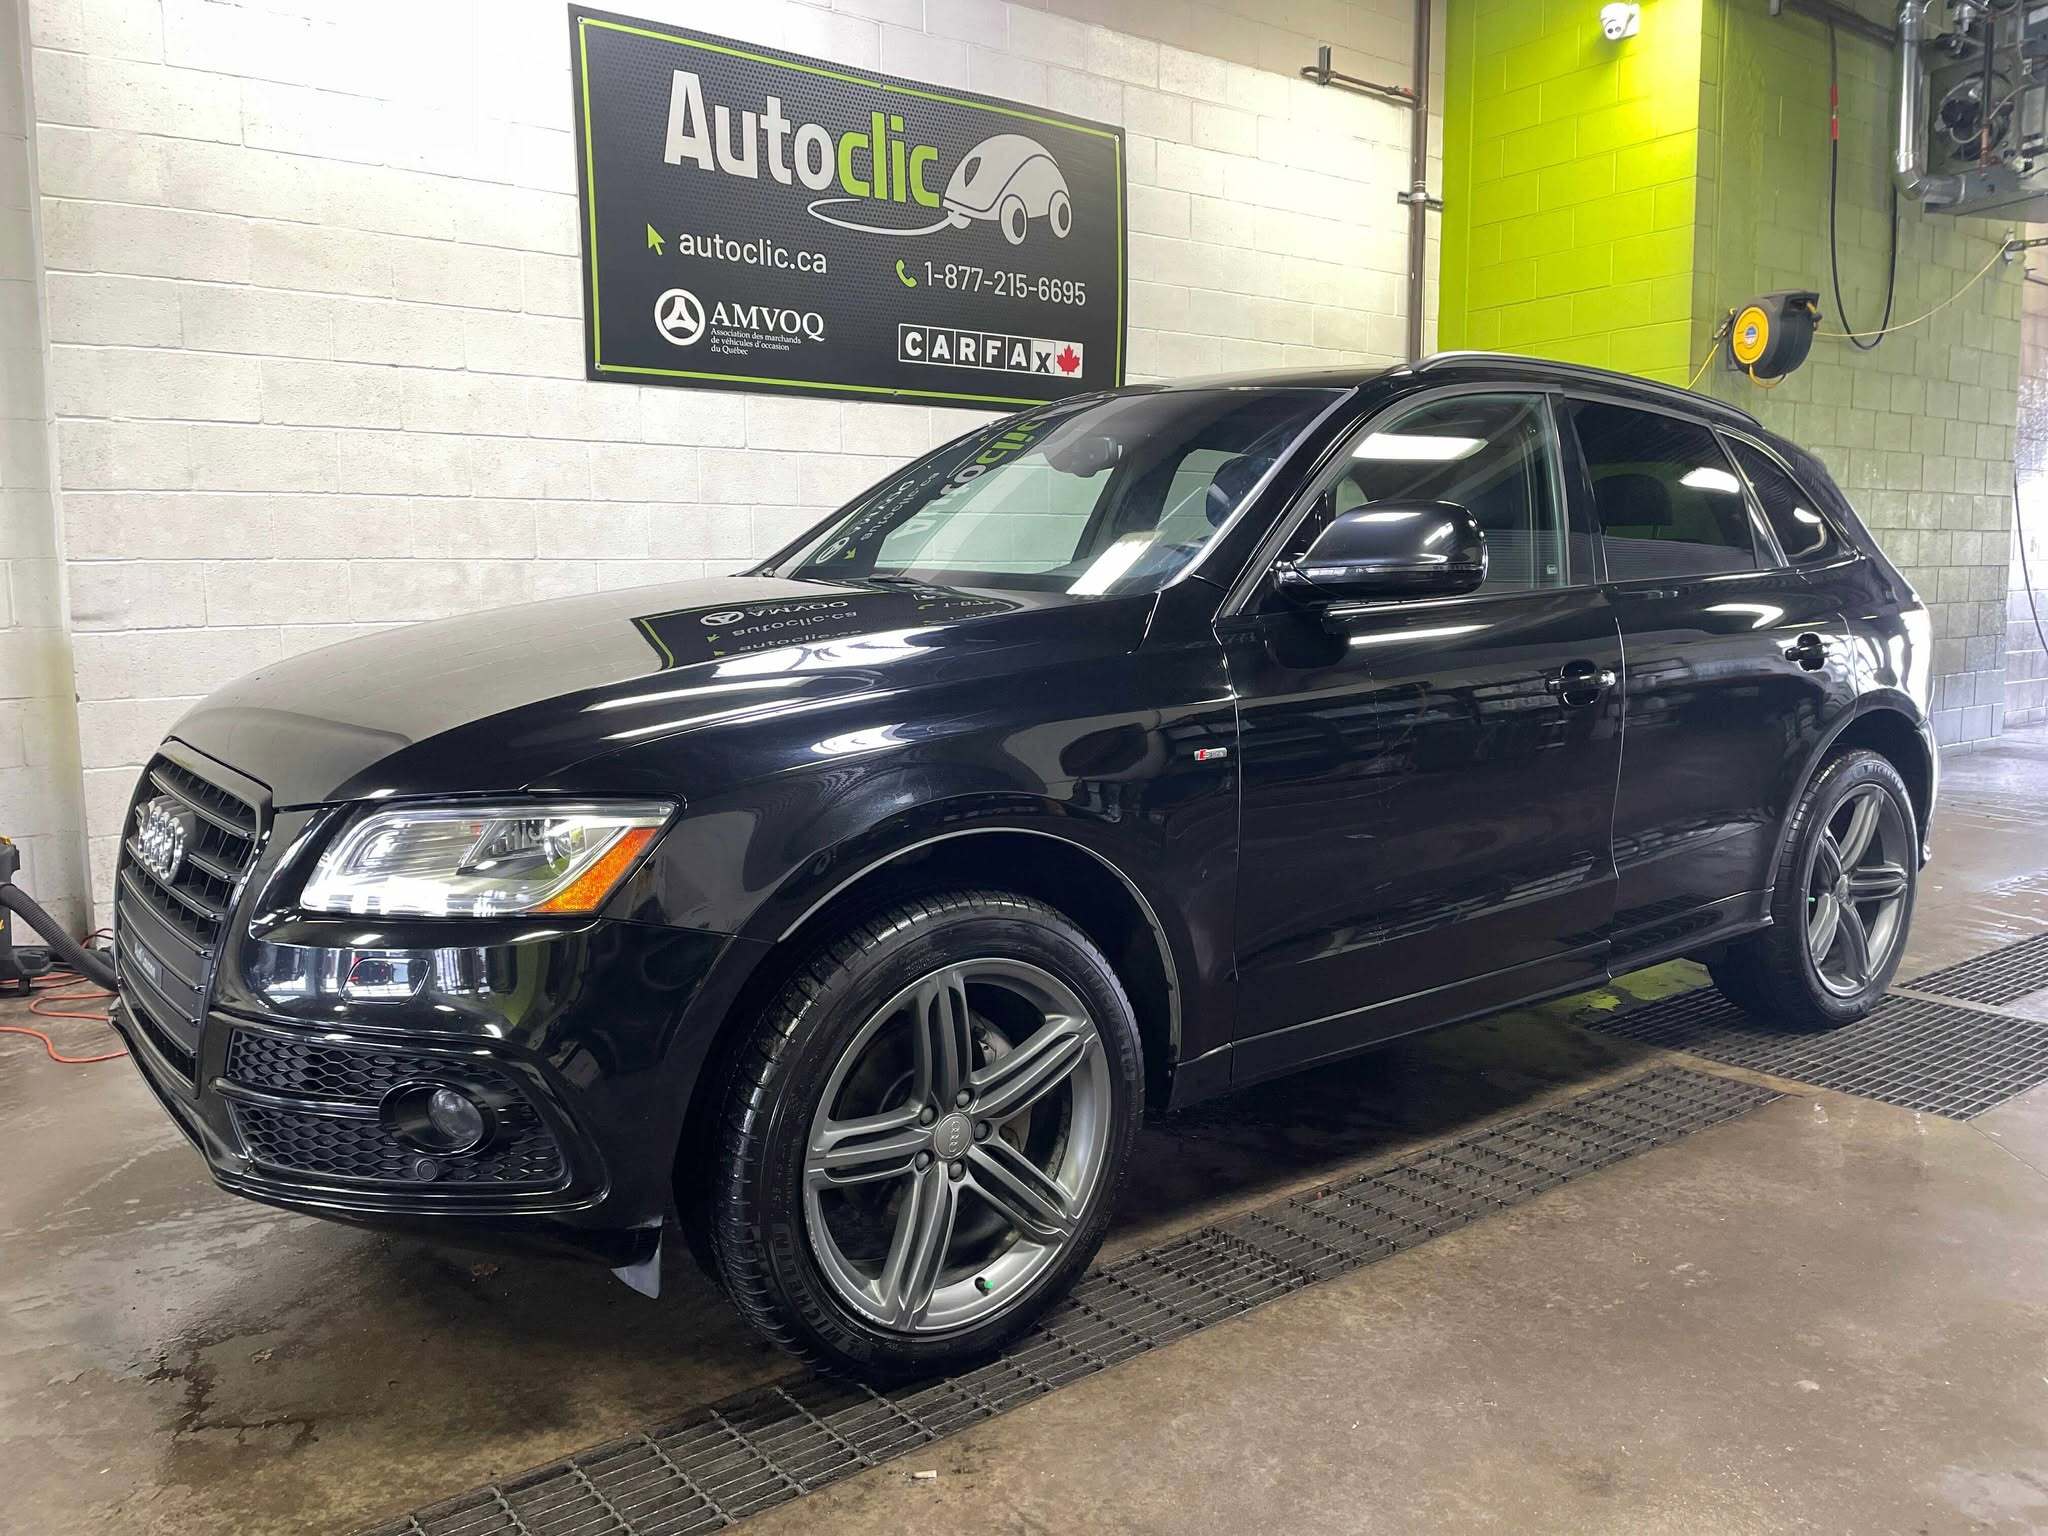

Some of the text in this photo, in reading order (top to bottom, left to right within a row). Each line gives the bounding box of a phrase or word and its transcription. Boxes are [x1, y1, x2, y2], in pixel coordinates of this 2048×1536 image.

[664, 69, 940, 209] Autoclic
[679, 232, 827, 274] autoclic.ca
[924, 261, 1087, 306] 1-877-215-6695
[710, 301, 825, 342] AMVOQ
[710, 327, 801, 344] Association des marchands
[710, 336, 720, 344] de
[722, 338, 753, 347] véhicules
[711, 344, 749, 355] du Québec
[905, 331, 1051, 374] CARFAX
